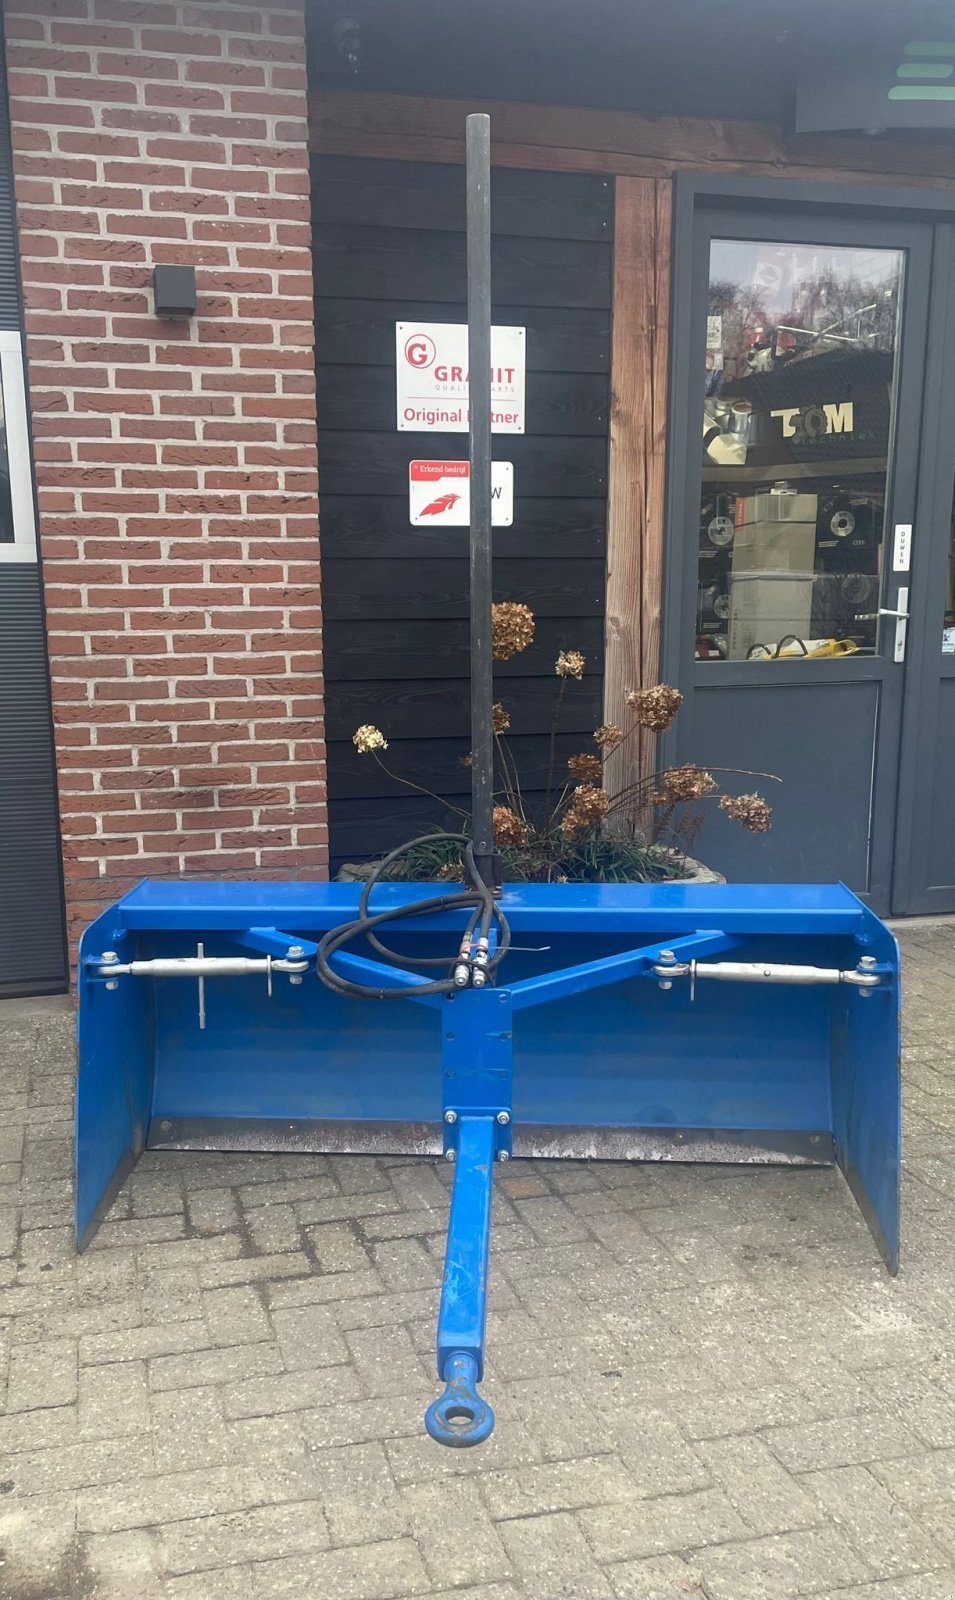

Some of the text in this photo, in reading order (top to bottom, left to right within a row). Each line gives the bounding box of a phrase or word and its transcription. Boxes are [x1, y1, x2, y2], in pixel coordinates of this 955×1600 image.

[407, 343, 428, 365] G
[434, 366, 515, 383] GRIT
[435, 383, 467, 391] QUALI
[404, 408, 462, 425] Original
[770, 402, 853, 437] TOM
[420, 465, 466, 474] Erkend bedrijf
